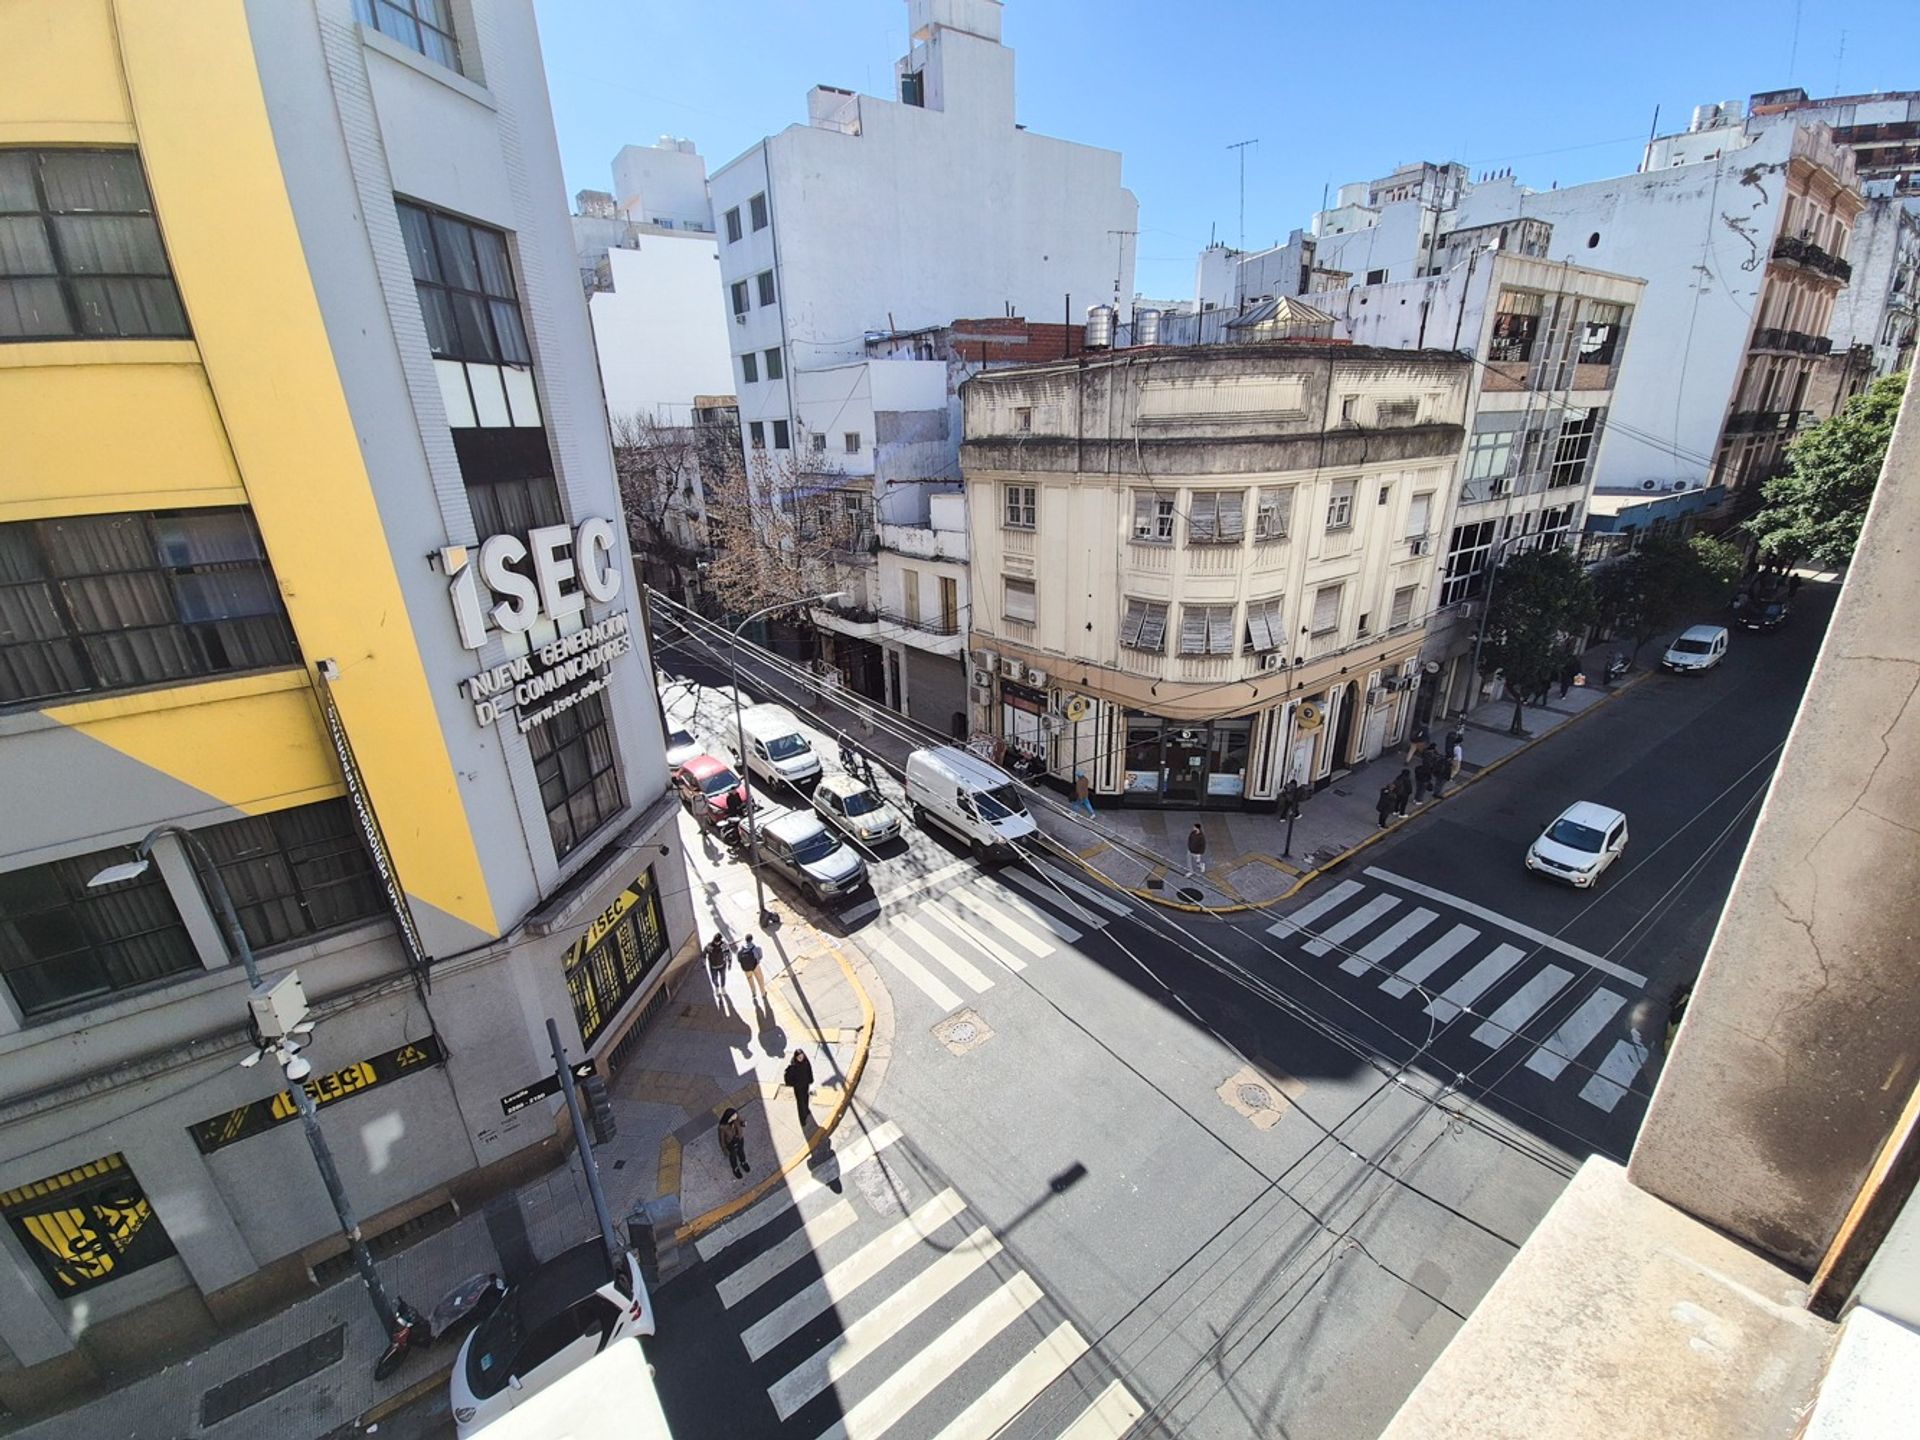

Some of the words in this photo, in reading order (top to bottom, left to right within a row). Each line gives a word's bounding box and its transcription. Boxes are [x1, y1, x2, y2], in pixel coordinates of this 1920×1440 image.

[469, 656, 534, 701] NUEVA
[474, 695, 505, 728] DE
[514, 635, 632, 706] COMUNICADORES
[518, 672, 614, 733] www.isec.edu.ar
[327, 707, 357, 792] DEPORTIVO
[354, 794, 389, 880] PERIODISMO
[503, 1090, 528, 1104] Lavalle
